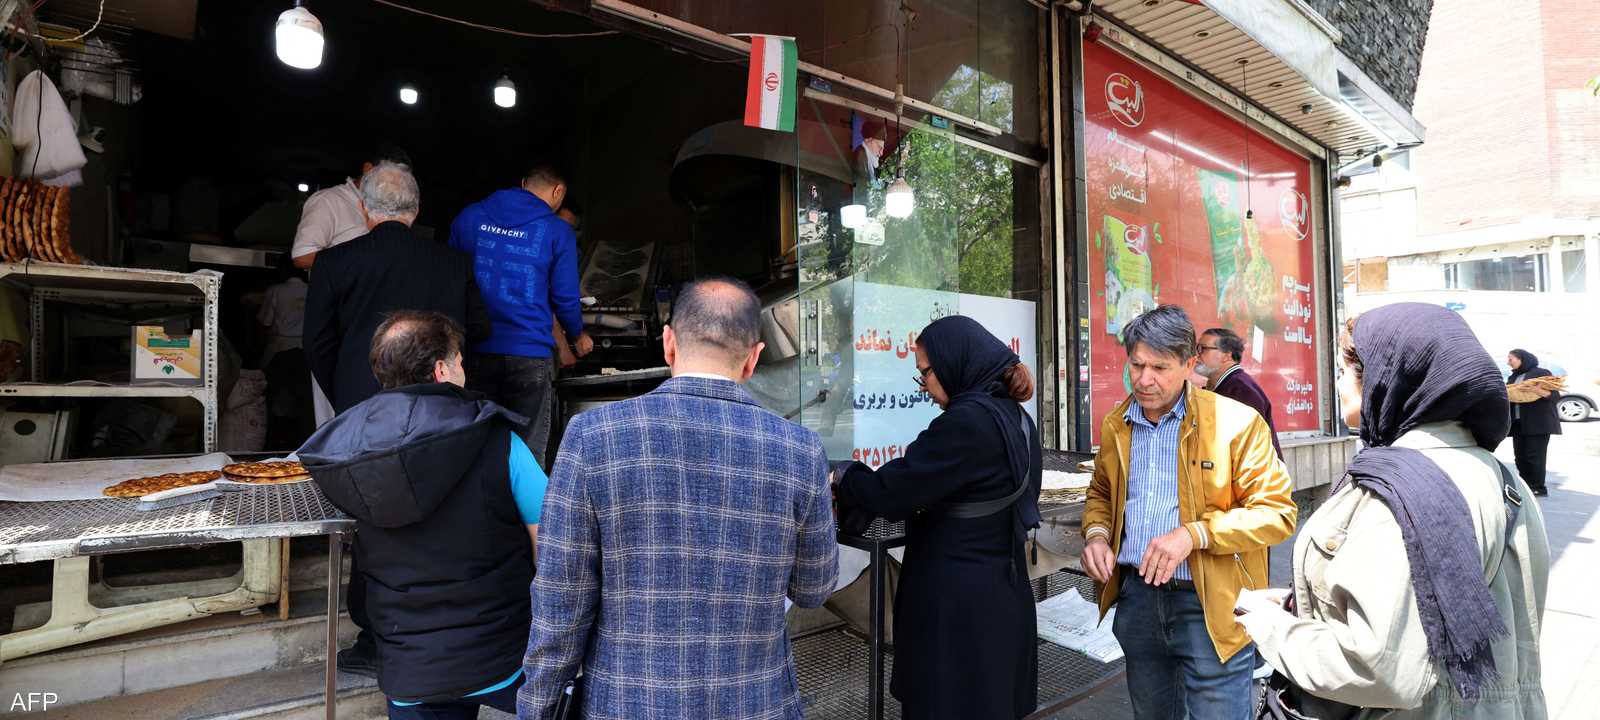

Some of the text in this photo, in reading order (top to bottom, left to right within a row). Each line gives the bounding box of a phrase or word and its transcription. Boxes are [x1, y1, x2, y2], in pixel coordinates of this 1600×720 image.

[1109, 183, 1147, 205] اقتصادی
[480, 224, 525, 239] GIVENCHY
[1282, 274, 1311, 302] پرچم
[855, 328, 892, 351] نماند
[1284, 325, 1312, 349] بالاست
[853, 392, 886, 410] بربری
[889, 394, 896, 409] و
